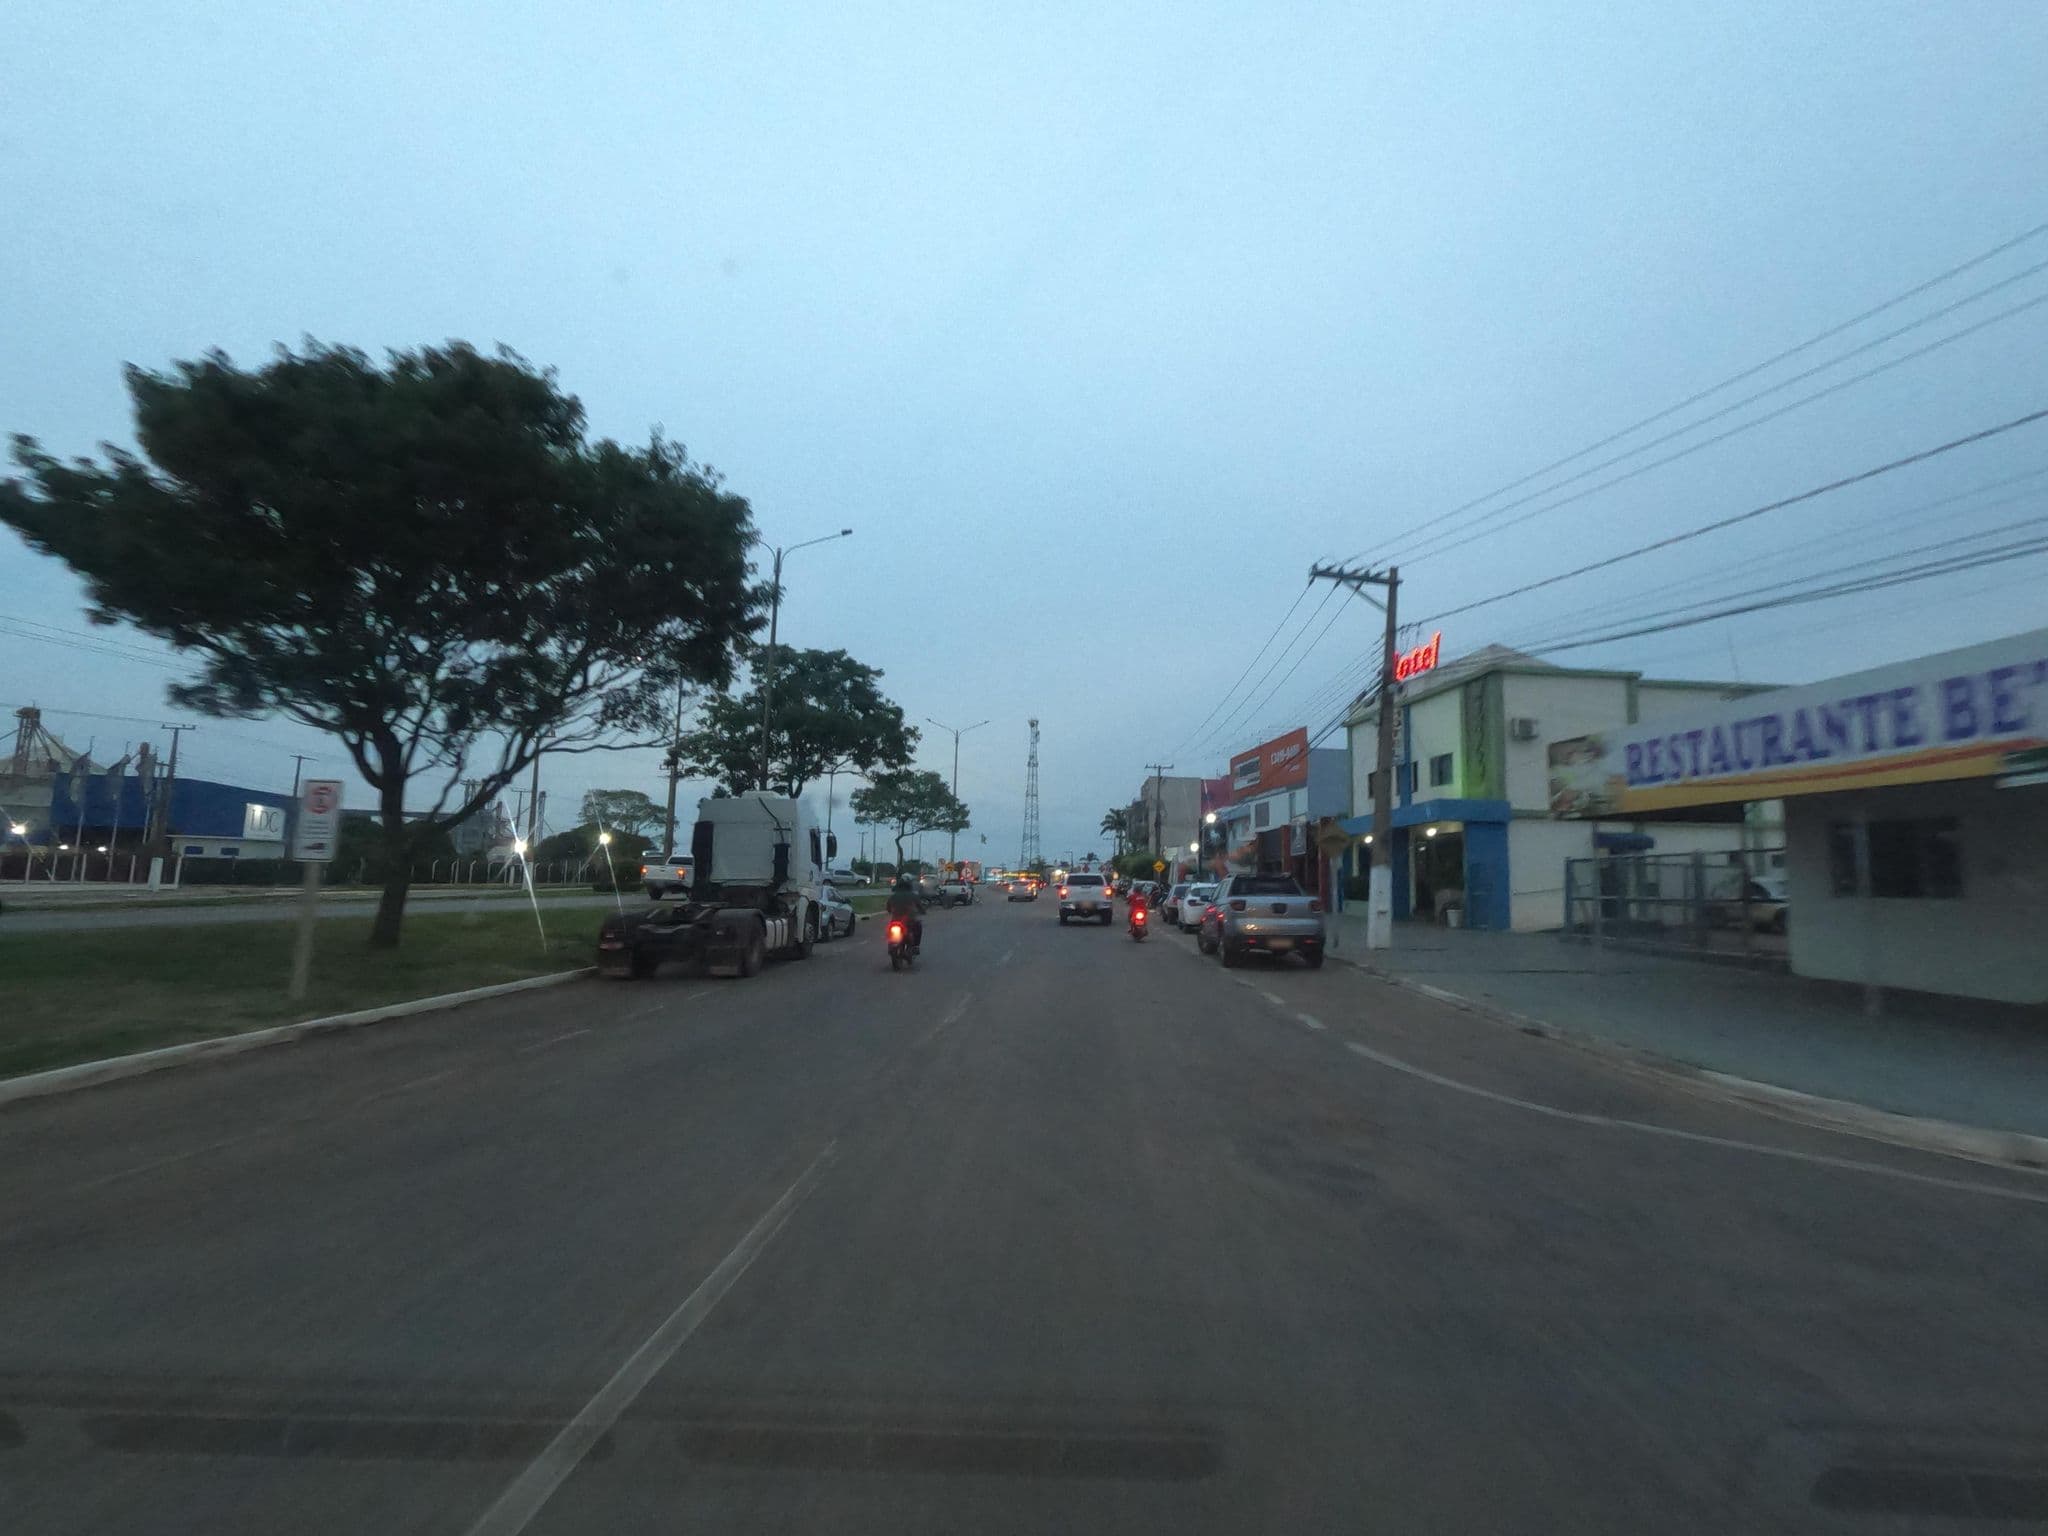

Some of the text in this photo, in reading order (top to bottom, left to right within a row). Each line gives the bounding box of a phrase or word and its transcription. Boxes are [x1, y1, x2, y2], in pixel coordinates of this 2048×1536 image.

[1393, 630, 1441, 681] otel
[1626, 658, 2048, 786] RESTAURANTE BE
